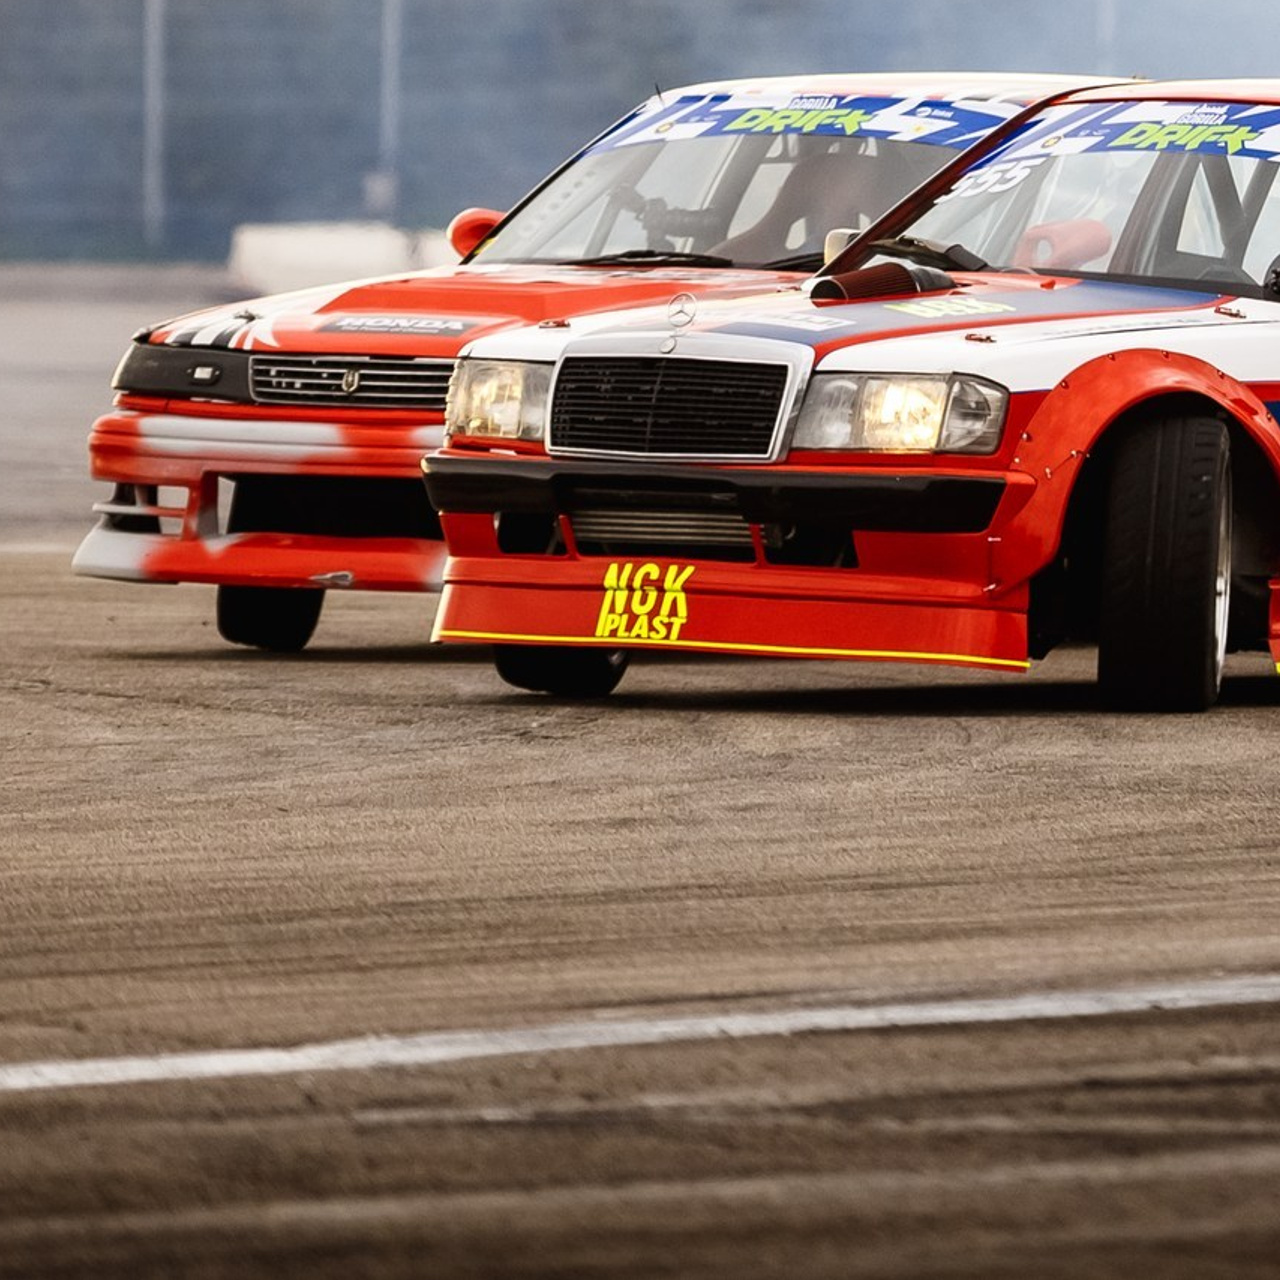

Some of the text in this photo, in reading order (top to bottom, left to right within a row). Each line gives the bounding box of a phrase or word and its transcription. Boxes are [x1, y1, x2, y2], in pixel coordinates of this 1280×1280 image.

[789, 97, 838, 110] GORILLA
[933, 158, 1047, 204] 555
[336, 317, 463, 330] HONDA
[595, 563, 695, 634] NGK
[603, 613, 687, 640] PLAST
